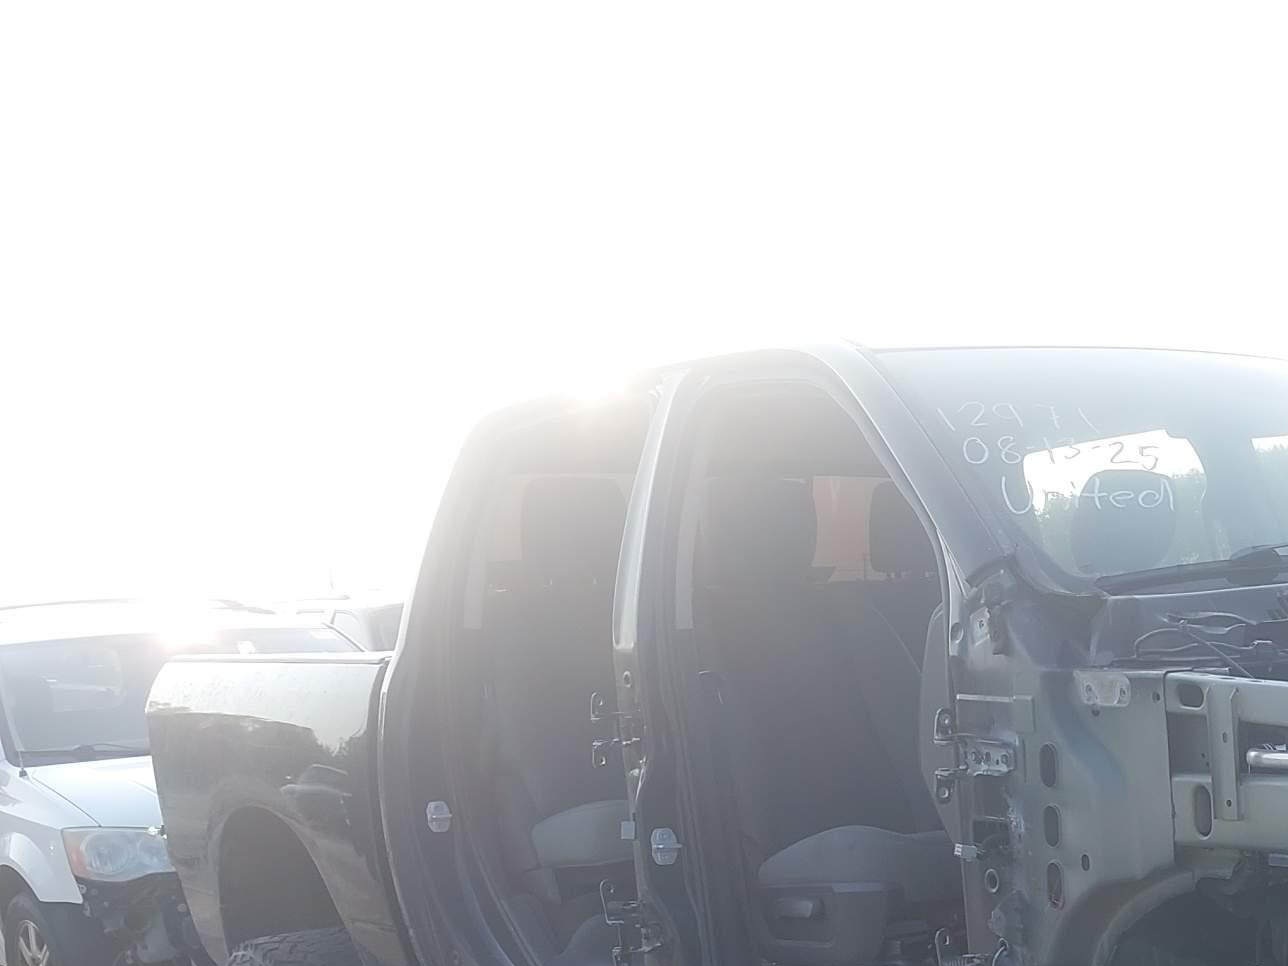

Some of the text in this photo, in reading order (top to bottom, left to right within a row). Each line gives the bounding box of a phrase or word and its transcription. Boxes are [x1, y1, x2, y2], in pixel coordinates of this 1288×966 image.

[936, 400, 1100, 433] 12971
[962, 435, 1159, 471] 08-13-25
[1000, 472, 1176, 515] United
